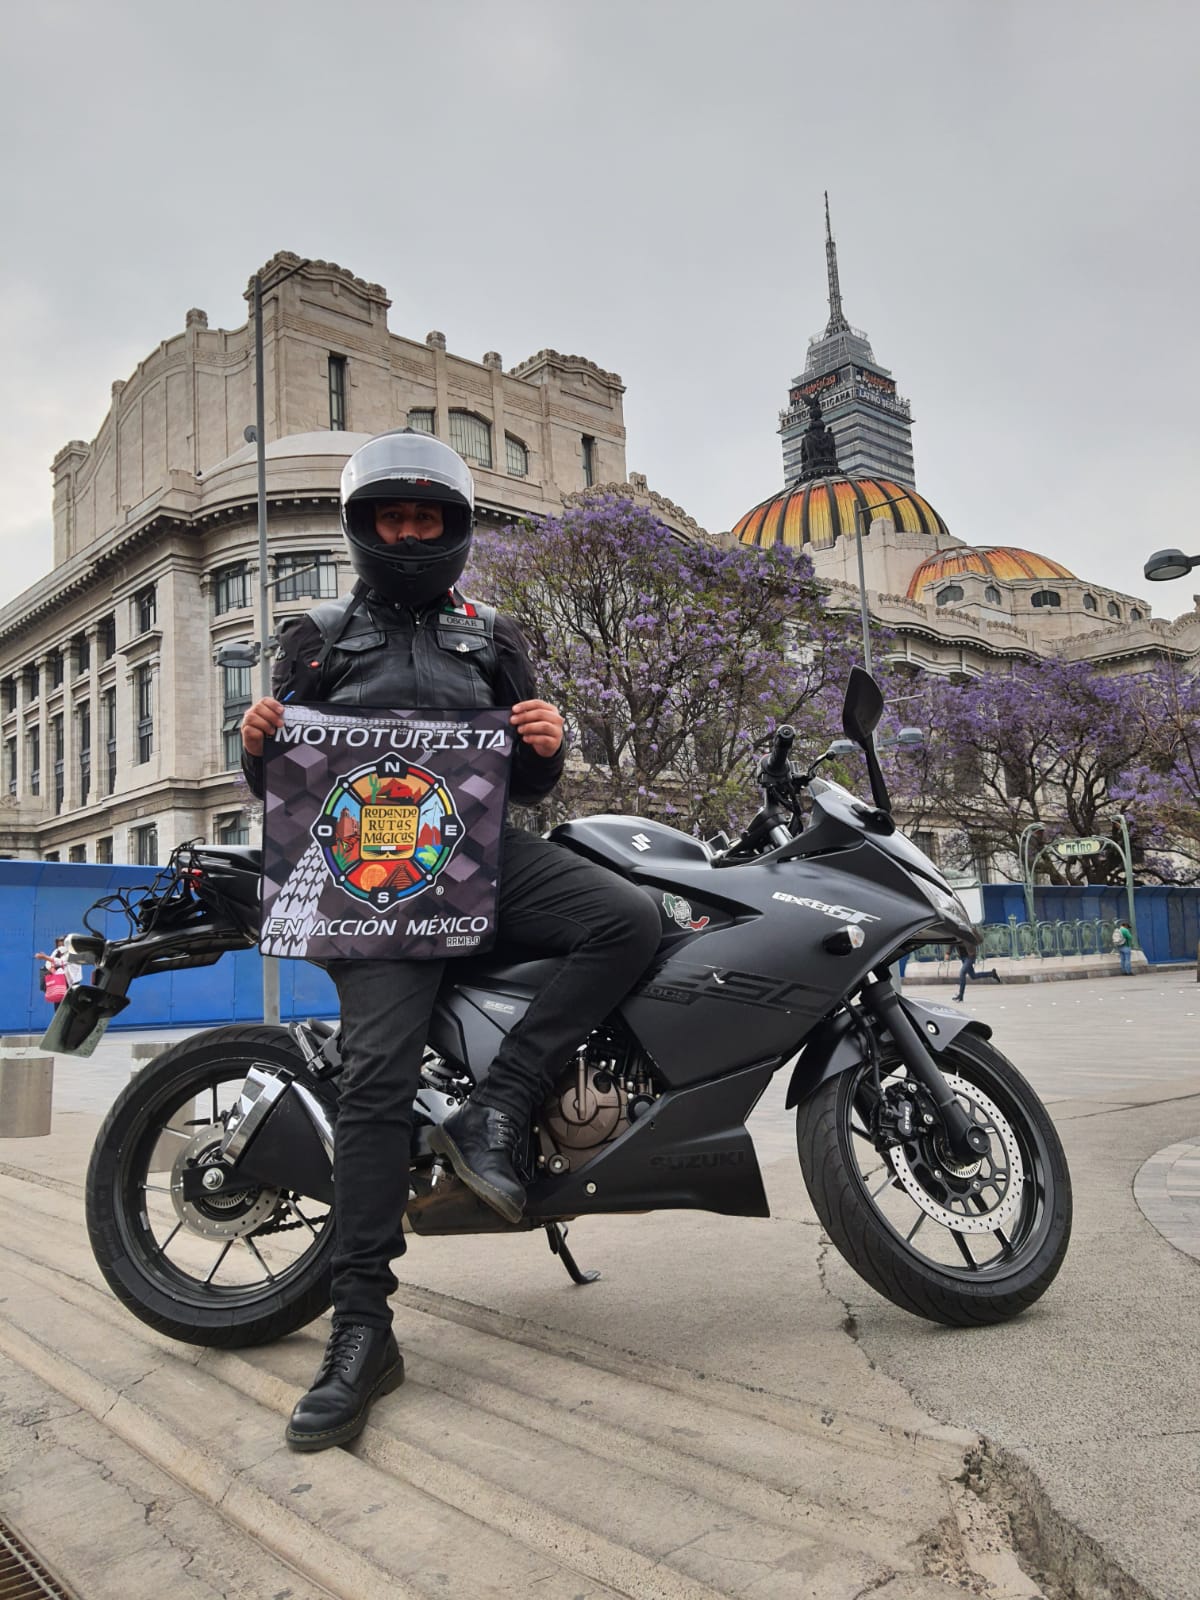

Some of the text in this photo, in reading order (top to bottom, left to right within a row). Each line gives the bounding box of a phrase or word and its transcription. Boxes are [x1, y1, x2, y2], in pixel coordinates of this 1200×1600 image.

[446, 616, 477, 627] OSCAR
[274, 723, 506, 750] MOTOTURISTA
[384, 761, 401, 773] N
[317, 824, 333, 836] O
[445, 824, 458, 836] E
[1065, 841, 1092, 855] METRO
[377, 891, 390, 904] S
[267, 914, 489, 936] EN ACCIÓN MÉXICO
[648, 1151, 745, 1169] SUZUKI
